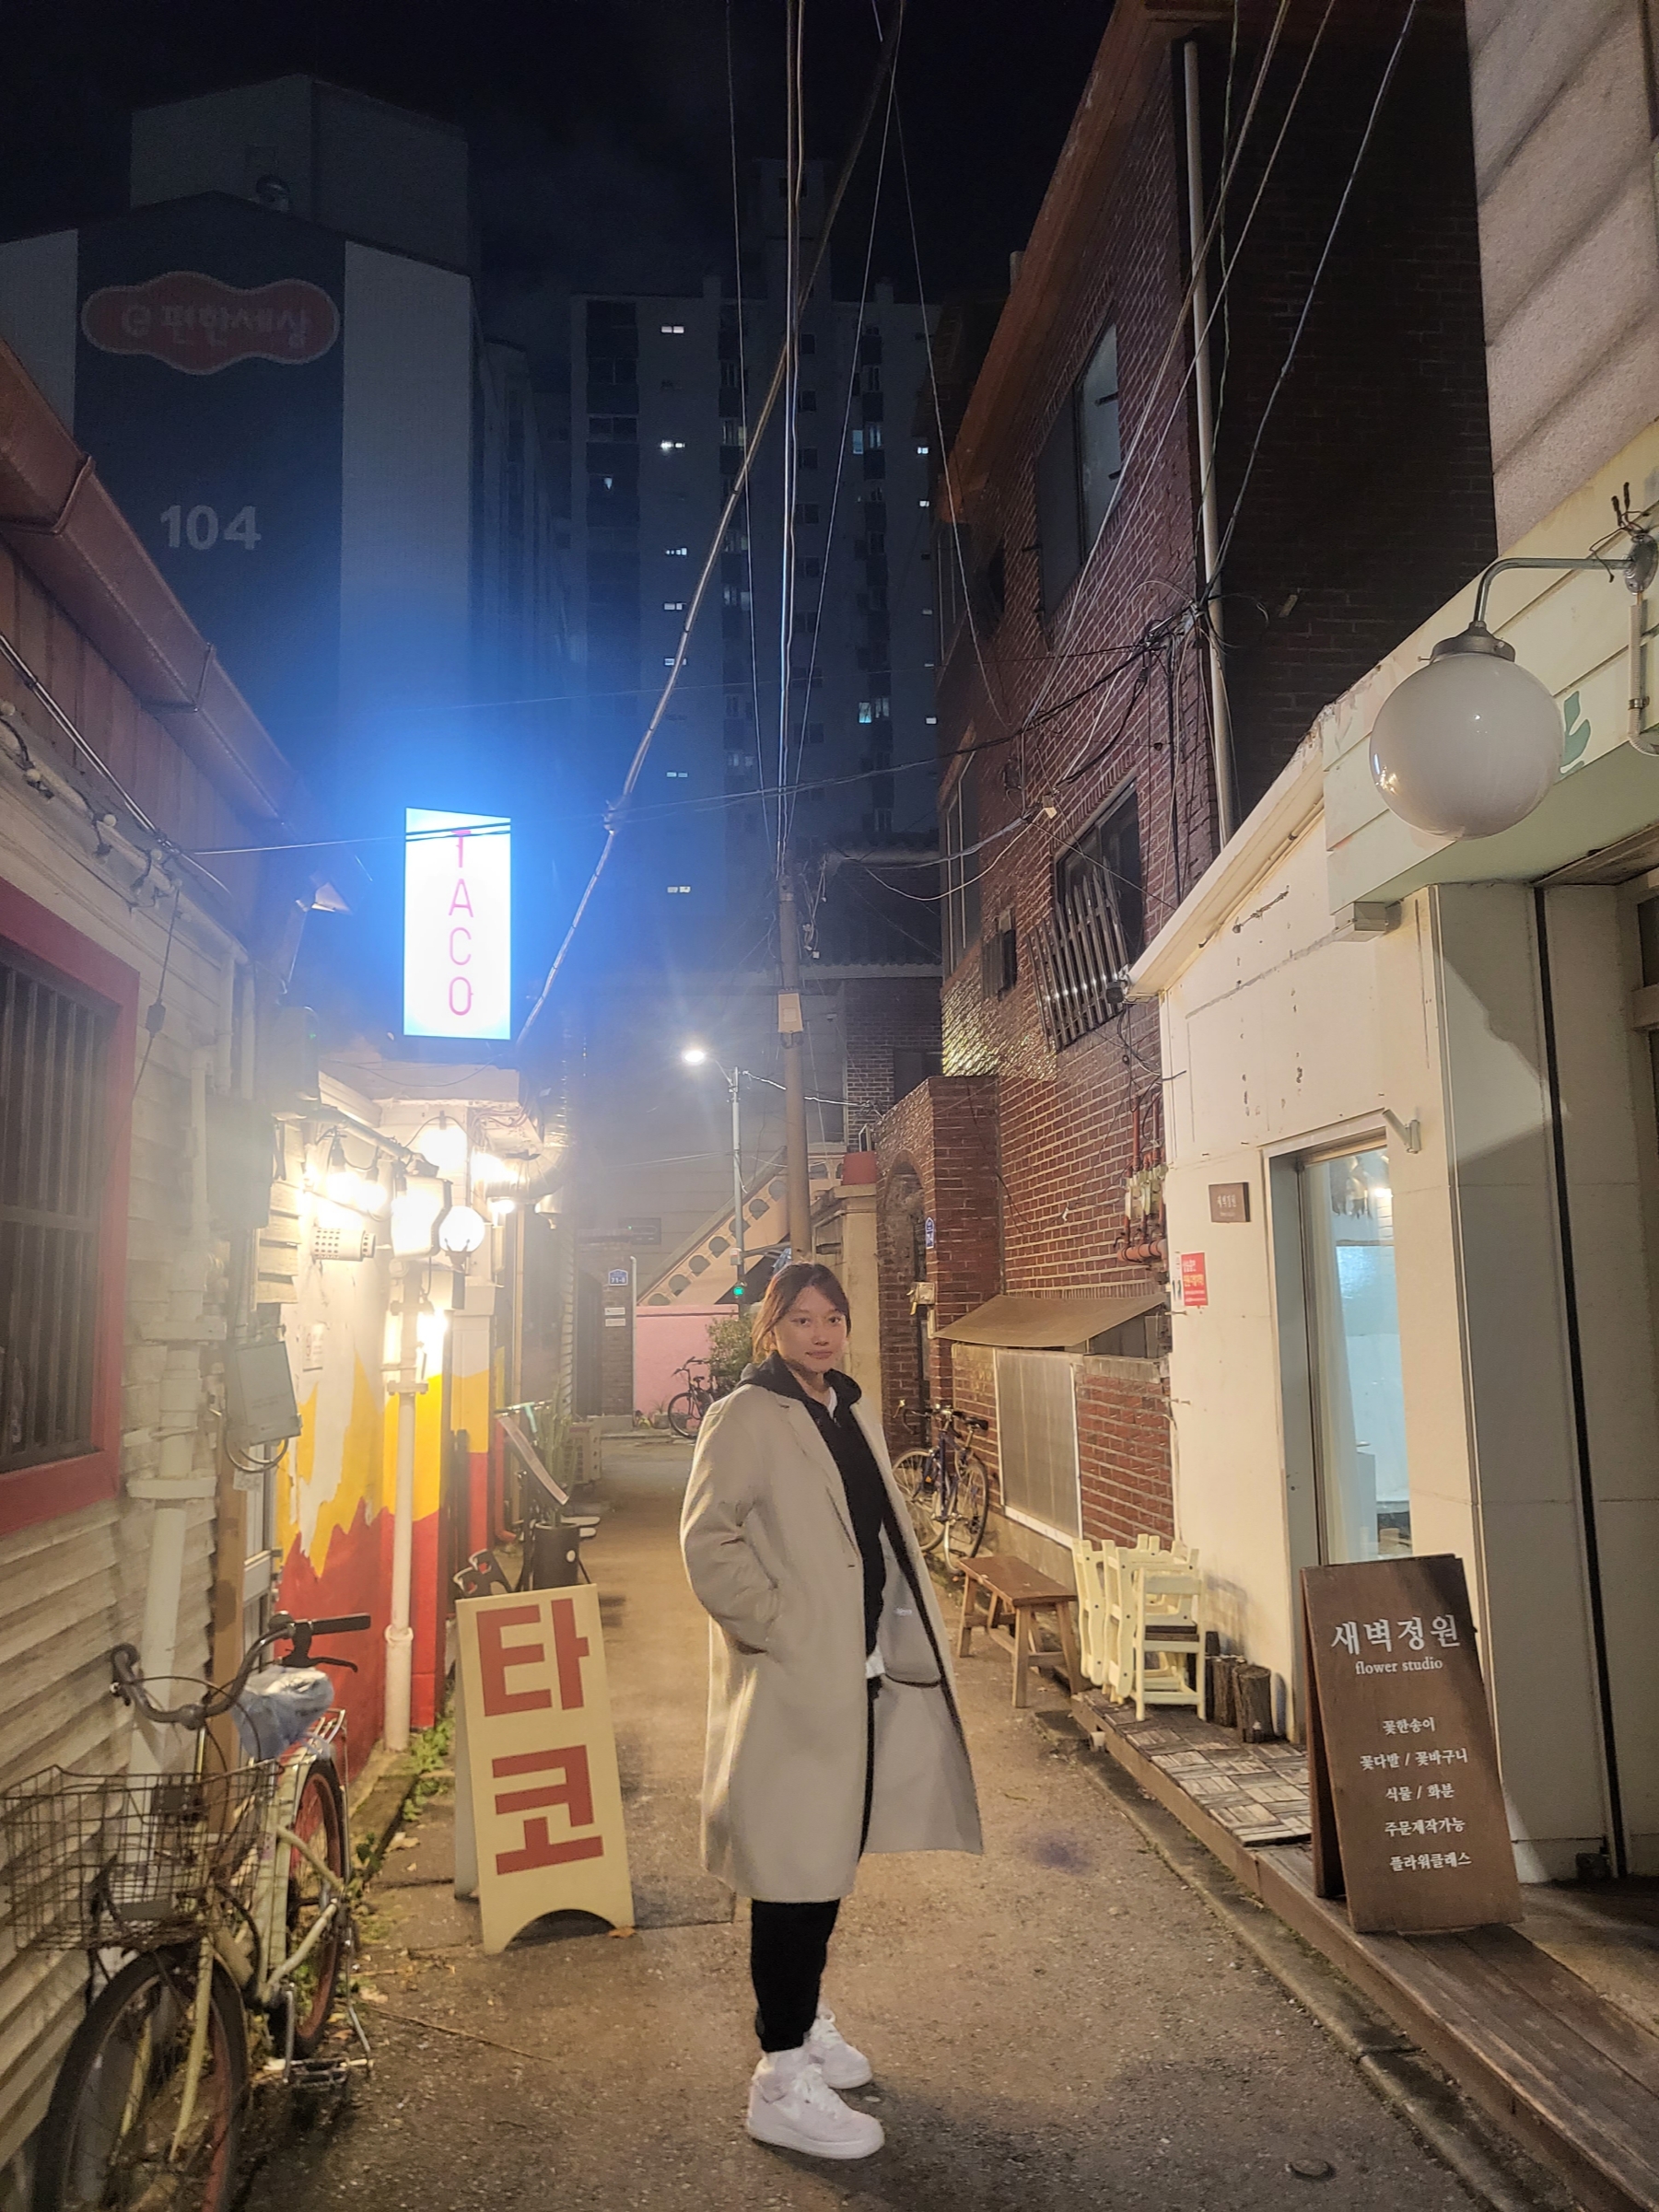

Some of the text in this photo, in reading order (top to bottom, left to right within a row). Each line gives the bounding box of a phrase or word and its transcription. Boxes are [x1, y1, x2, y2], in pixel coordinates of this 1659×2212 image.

[159, 504, 263, 551] 104
[447, 828, 475, 1017] TACO
[1330, 1613, 1462, 1656] 새벽정원
[1355, 1657, 1443, 1675] flower studio
[475, 1597, 605, 1876] 타코
[1383, 1717, 1436, 1735] 꽃한송이
[1360, 1752, 1400, 1771] 꽃다발
[1415, 1748, 1469, 1767] 꽃바구니
[1385, 1786, 1413, 1803] 식물
[1427, 1783, 1455, 1800] 화분
[1384, 1817, 1466, 1838] 주문제작가능
[1389, 1851, 1473, 1872] 플라워클래스
